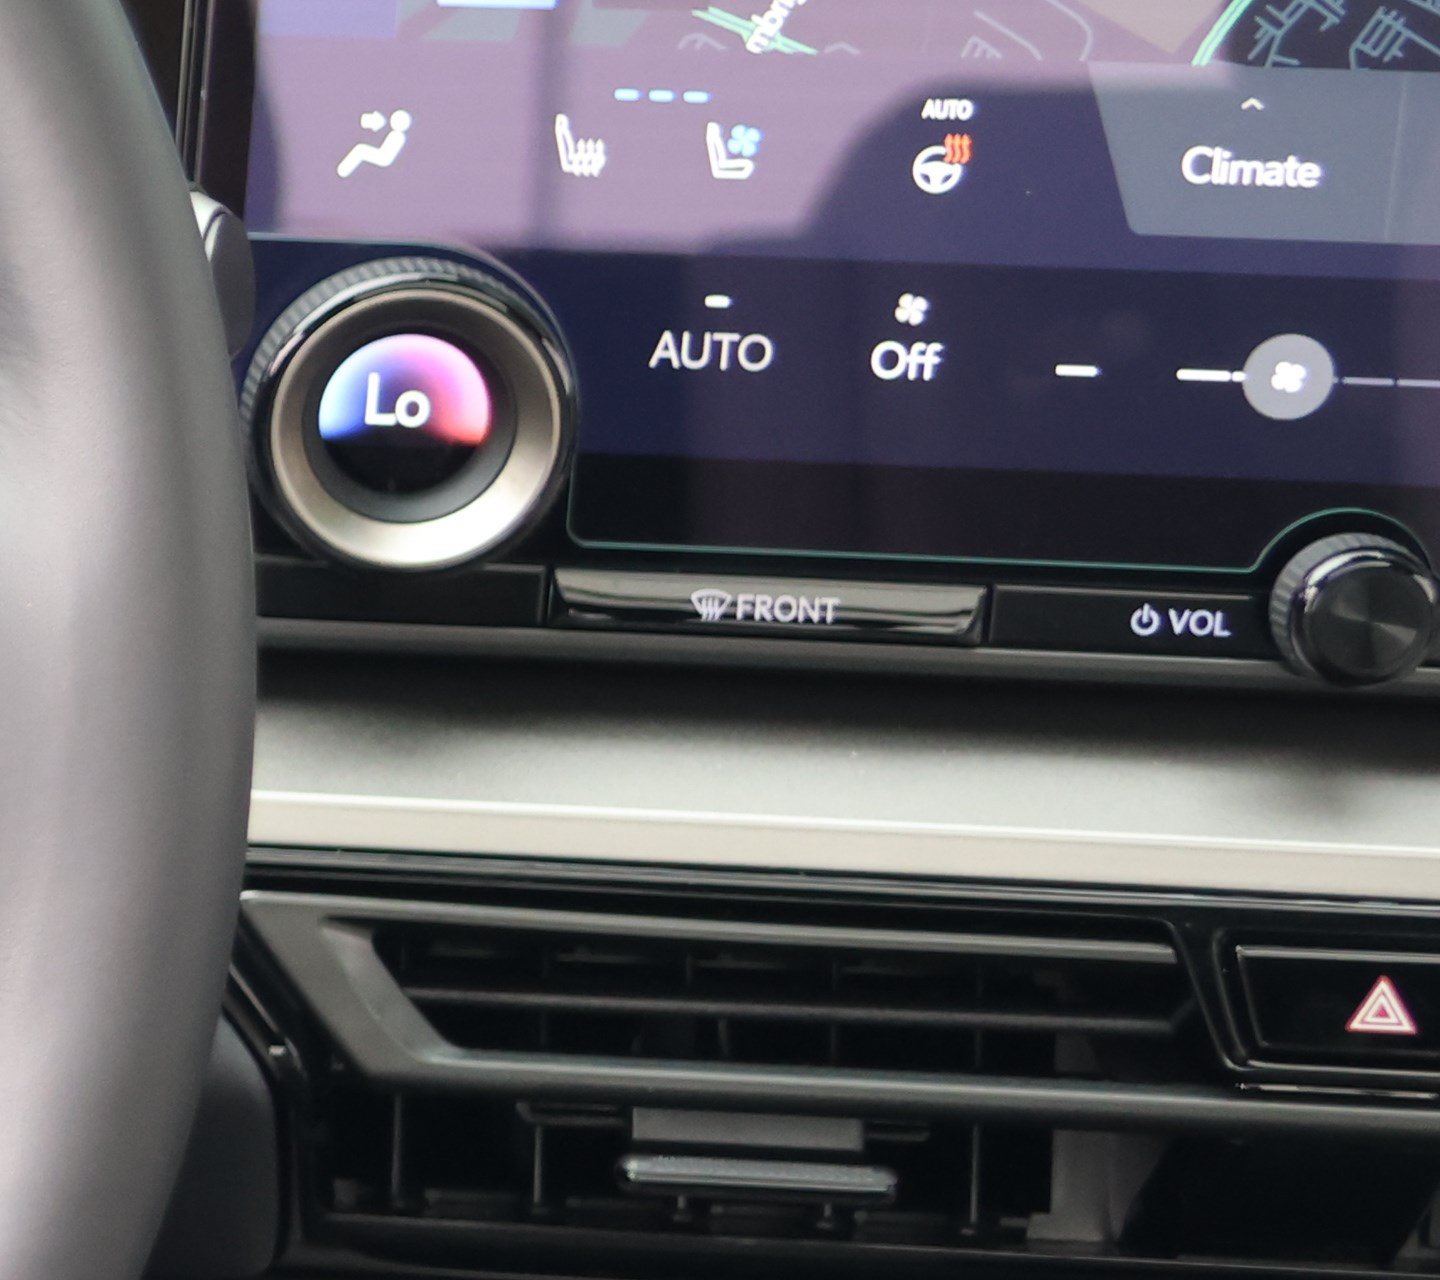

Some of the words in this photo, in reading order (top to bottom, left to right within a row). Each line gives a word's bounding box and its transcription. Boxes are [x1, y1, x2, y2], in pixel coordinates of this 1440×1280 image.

[921, 98, 976, 122] AUTO
[1180, 144, 1323, 190] Climate
[647, 330, 776, 372] AUTO
[870, 340, 946, 382] Off
[363, 371, 432, 429] Lo
[736, 593, 841, 626] FRONT
[1168, 608, 1232, 638] VOL
